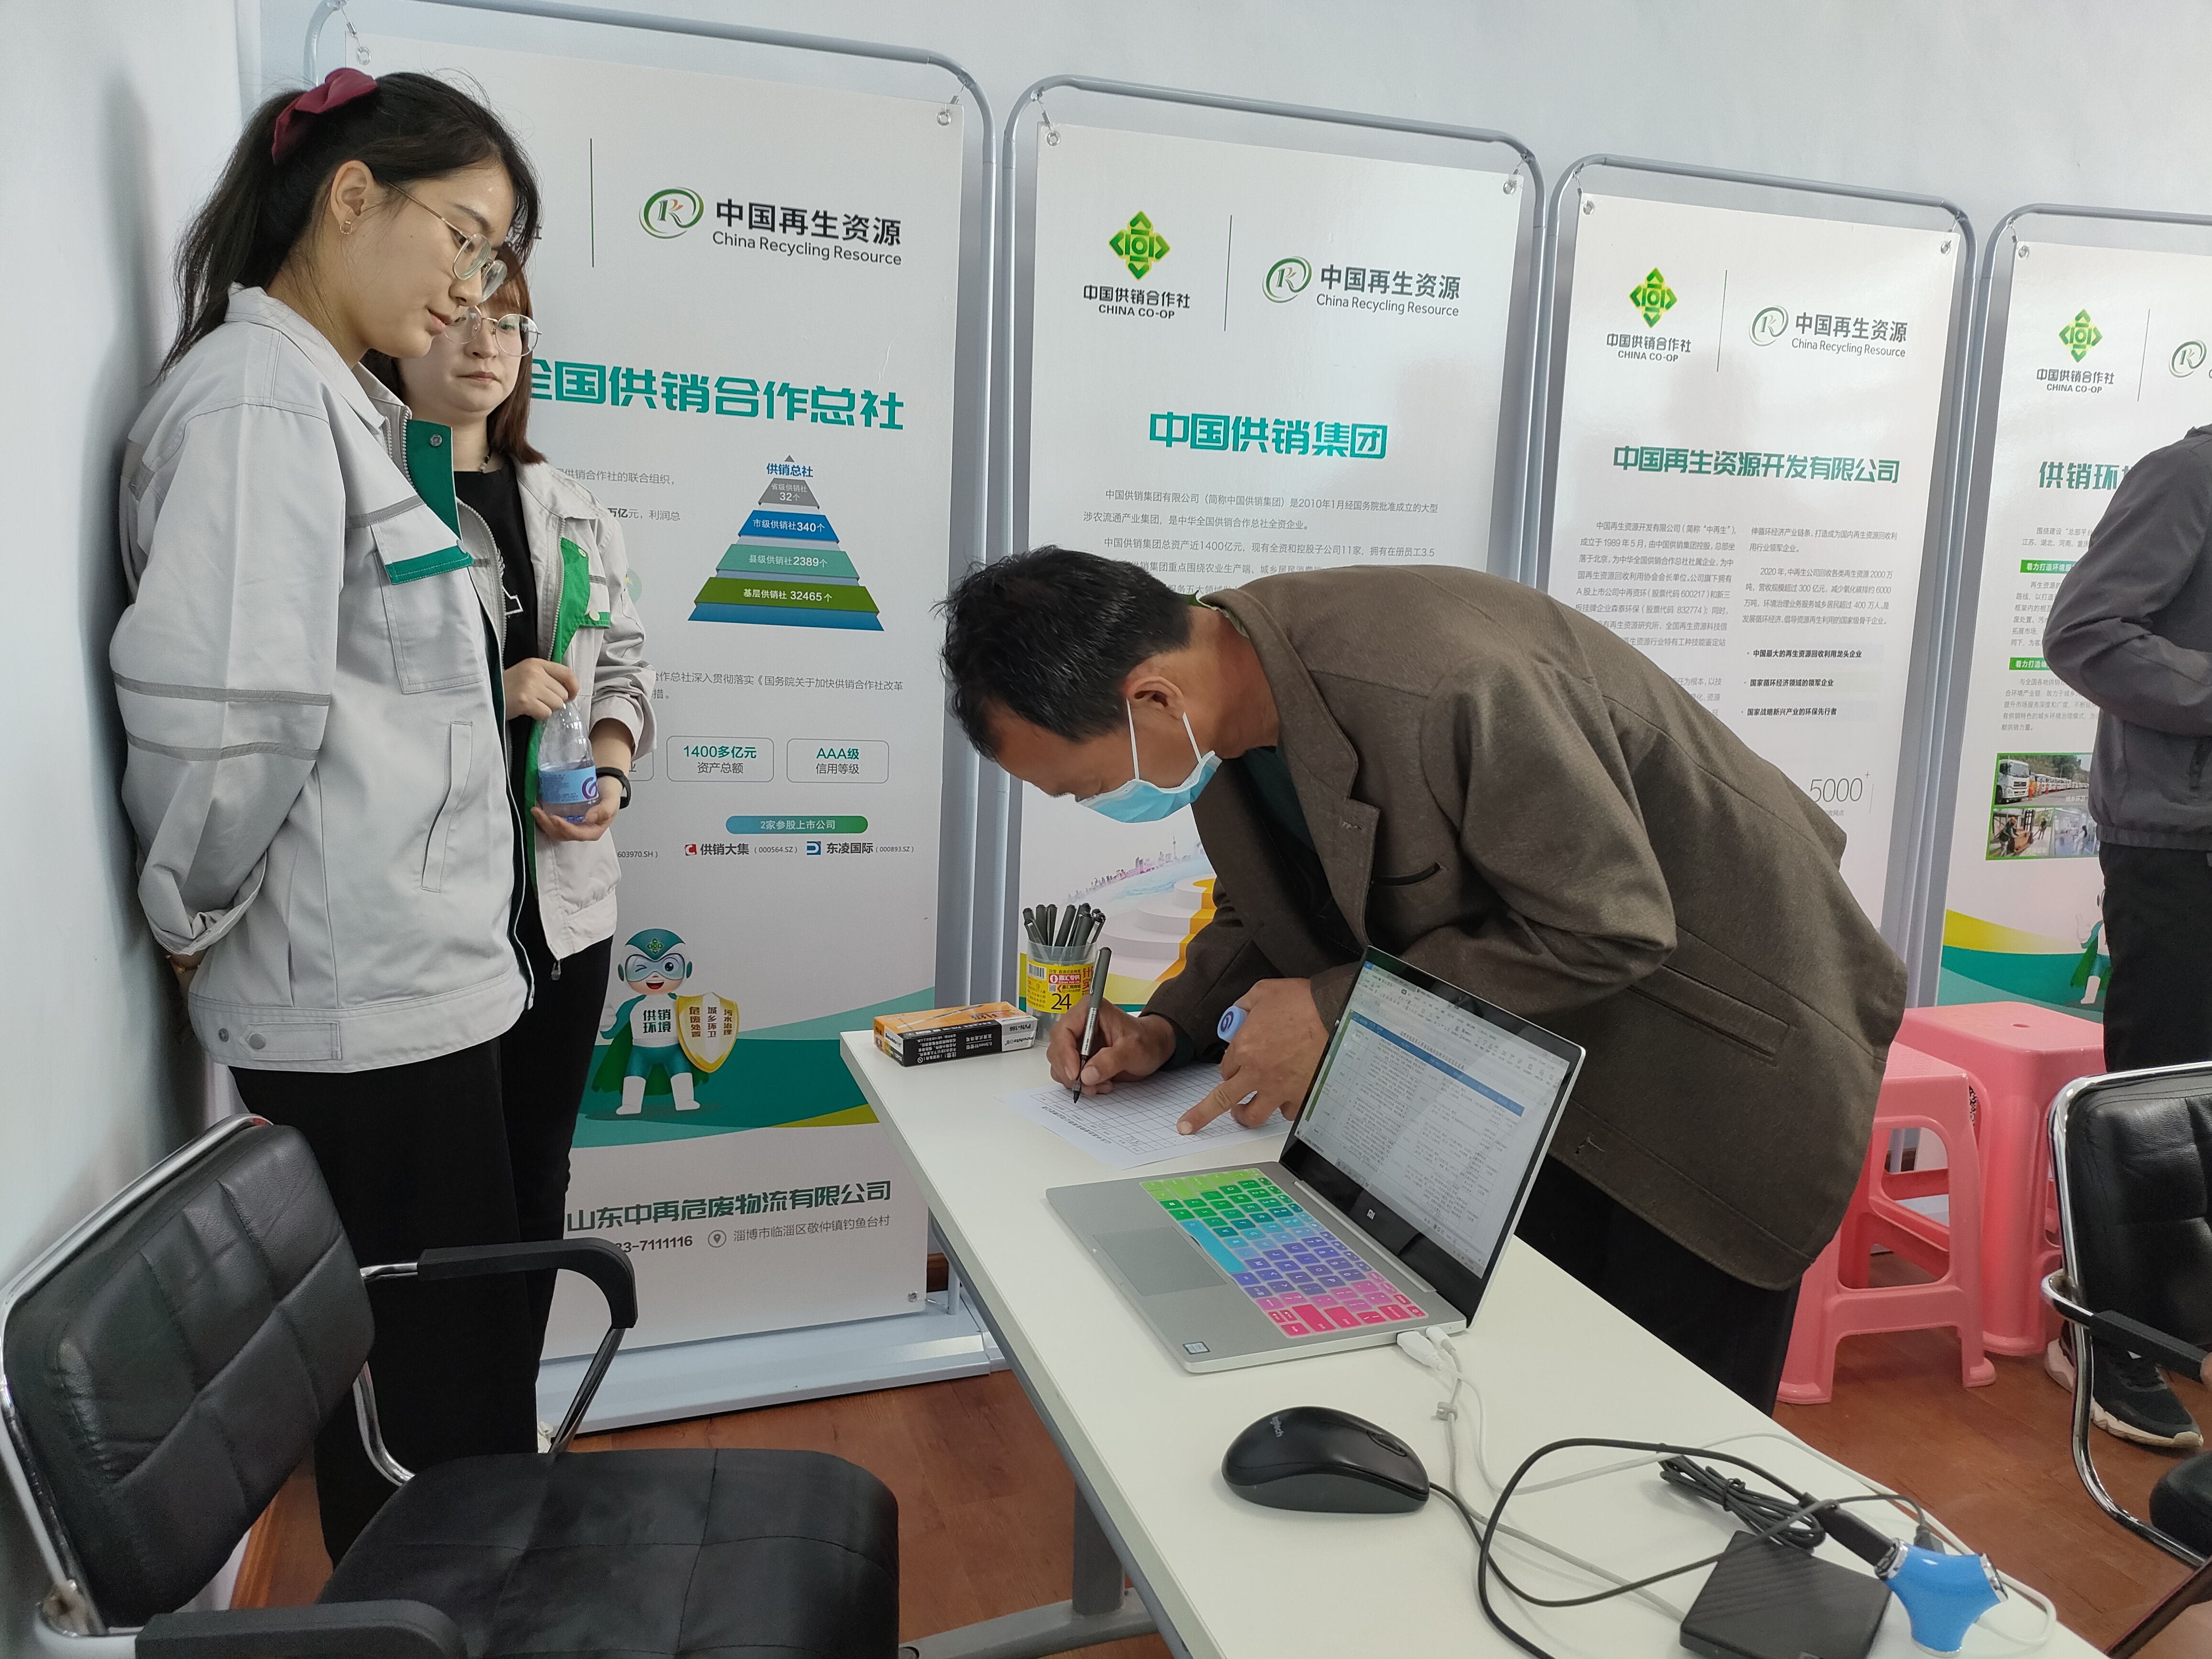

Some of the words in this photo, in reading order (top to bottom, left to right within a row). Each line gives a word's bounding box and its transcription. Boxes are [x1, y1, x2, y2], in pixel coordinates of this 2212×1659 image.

[716, 199, 901, 247] 中国再生资源
[712, 231, 755, 250] China
[760, 237, 830, 261] Recycling
[834, 245, 902, 265] Resource
[1320, 264, 1461, 301] 中国再生资源
[1084, 284, 1190, 309] 中国供销合作社
[1098, 304, 1135, 316] CHINA
[1139, 308, 1175, 320] CO-OP
[1316, 293, 1349, 309] China
[1351, 297, 1405, 315] Recycling
[1407, 302, 1459, 317] Resource
[1795, 312, 1908, 343] 中国再生资源
[1606, 333, 1692, 353] 中国供销合作社
[1792, 338, 1818, 350] China
[1820, 341, 1862, 356] Recycling
[1864, 345, 1906, 358] Resource
[1618, 350, 1648, 361] CHINA
[1649, 353, 1679, 362] CO-OP
[2036, 369, 2114, 385] 中国供销合作社
[2046, 384, 2074, 392] CHINA
[2075, 385, 2102, 394] CO-OP
[1150, 411, 1388, 460] 中国供销集团
[766, 462, 814, 478] 供销总社
[1613, 445, 1900, 484] 中国再生资源开发有限公司
[2039, 461, 2133, 491] 供销环
[771, 482, 807, 494] 省级供销社
[779, 492, 800, 502] 32个
[752, 519, 826, 533] 市级供销社340个
[749, 554, 828, 568] 县级供销社2389个
[743, 588, 787, 600] 基层供销社
[790, 590, 832, 603] 32465个
[683, 745, 757, 760] 1400多亿元
[816, 747, 860, 761] AAA级
[697, 761, 744, 775] 资产总额
[816, 762, 860, 775] 信用等级
[760, 819, 836, 830] 2家参股上市公司
[700, 842, 750, 856] 供销大集
[826, 841, 874, 855] 东凌国际
[1051, 993, 1072, 1010] 24
[707, 1006, 718, 1038] 城乡环卫
[723, 1008, 733, 1036] 污水治理
[1009, 1023, 1031, 1031] PVN-166
[566, 1180, 891, 1232] 山东中再危废物流有限公司
[733, 1215, 890, 1242] 淄博市临淄区敬仲镇钓鱼台村
